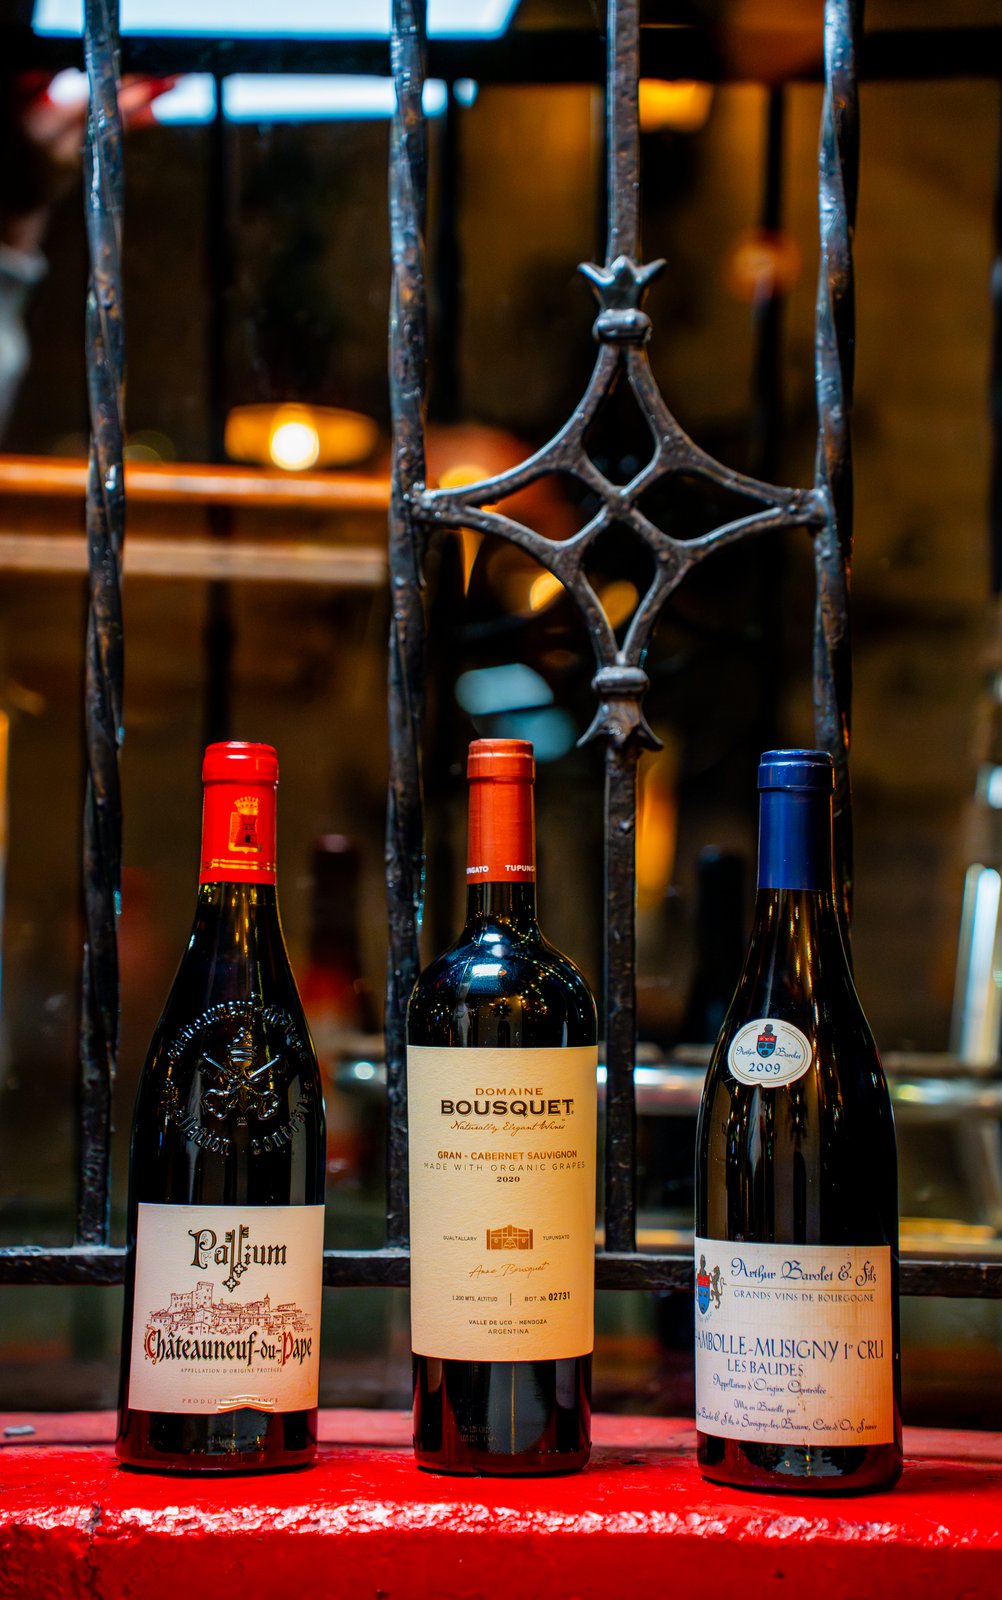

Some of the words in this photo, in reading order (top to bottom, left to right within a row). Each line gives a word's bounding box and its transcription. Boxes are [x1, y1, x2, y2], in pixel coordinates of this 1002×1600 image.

[748, 1062, 781, 1075] 2009
[475, 1087, 543, 1096] DOMAINE
[450, 1120, 498, 1133] Naturally
[502, 1120, 536, 1136] Elegant
[437, 1151, 462, 1160] GRAN
[471, 1151, 524, 1161] CABERNET
[527, 1150, 578, 1160] SAUVIGNON
[424, 1162, 448, 1171] MADE
[454, 1164, 483, 1172] WITH
[490, 1164, 547, 1172] ORGANIC
[552, 1161, 586, 1171] GRAPES
[187, 1224, 288, 1292] Pallium
[469, 1264, 496, 1279] Anne
[731, 1257, 776, 1284] Arthur
[780, 1259, 834, 1280] Barolet
[855, 1260, 877, 1287] Fils
[548, 1291, 571, 1302] 02731
[733, 1289, 771, 1300] GRANDS
[774, 1292, 799, 1301] VINS
[801, 1293, 814, 1302] DE
[818, 1293, 874, 1303] BOURGOGNE
[144, 1328, 312, 1367] Châteauneuf-du-Pape
[696, 1330, 840, 1363] AMBOLLE-MUSIGNY
[857, 1339, 884, 1360] CRU
[727, 1358, 747, 1373] LES
[749, 1359, 804, 1377] BAUDES
[713, 1373, 747, 1391] Appellation
